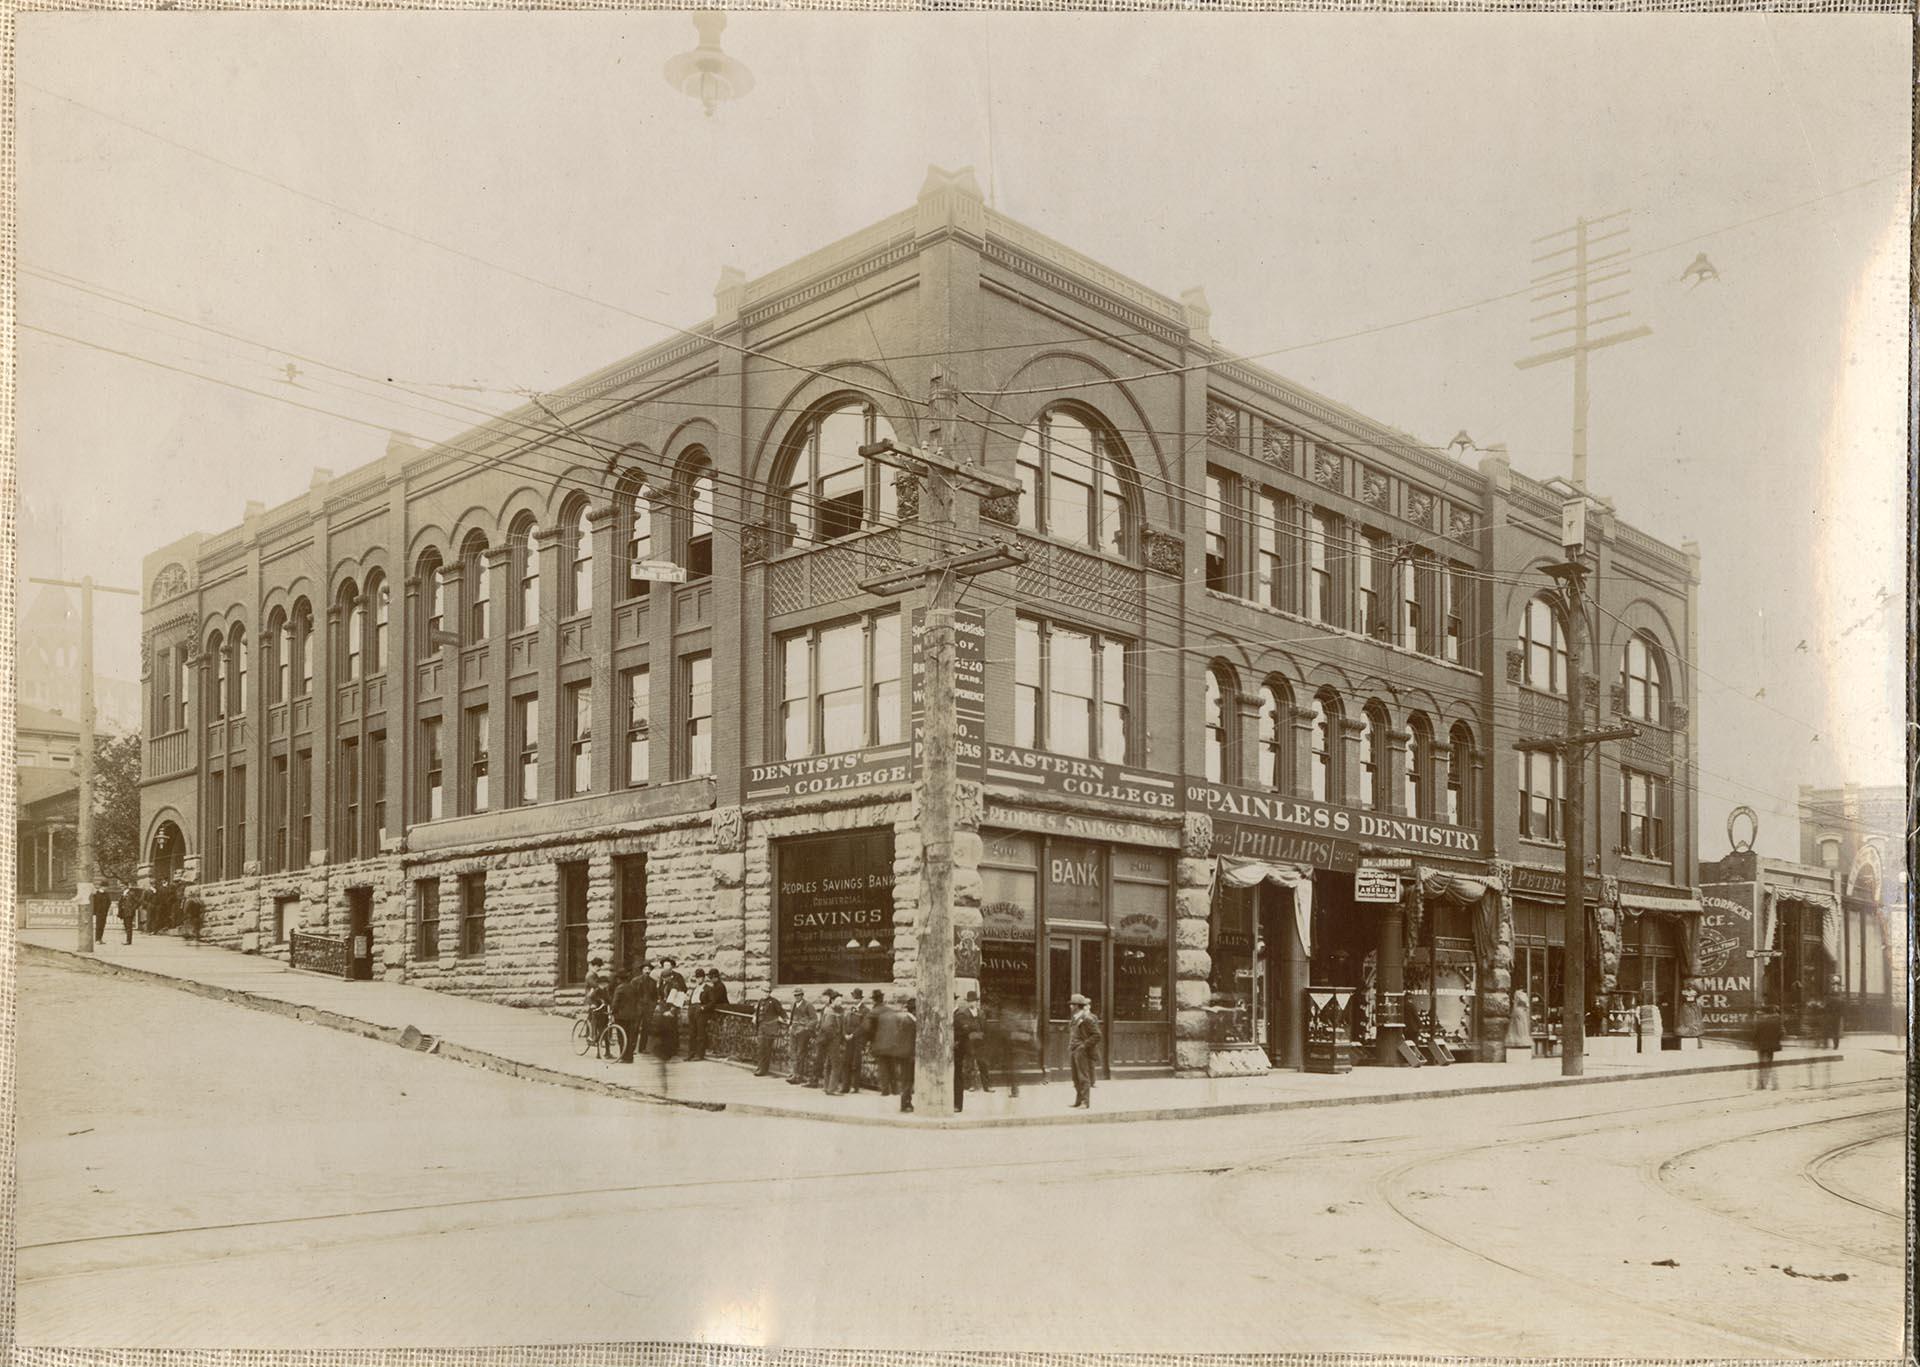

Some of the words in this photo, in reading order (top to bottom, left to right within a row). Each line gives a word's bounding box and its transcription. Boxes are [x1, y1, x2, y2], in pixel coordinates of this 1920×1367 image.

[955, 740, 981, 759] GAS
[988, 746, 1104, 780] EASTERN
[794, 765, 905, 795] COLLEGE
[1063, 778, 1175, 807] COLLEGE
[1066, 816, 1124, 838] SAVINGS
[1130, 823, 1170, 844] BANK
[1187, 785, 1208, 802] OF
[1207, 788, 1350, 832] PAINLESS
[1359, 815, 1482, 851] DENTISTRY
[1238, 831, 1330, 864] PHILLIPS
[823, 878, 863, 892] SAVINGS
[869, 874, 895, 888] BANK
[1052, 859, 1099, 888] BANK
[794, 909, 882, 927] SAVINGS
